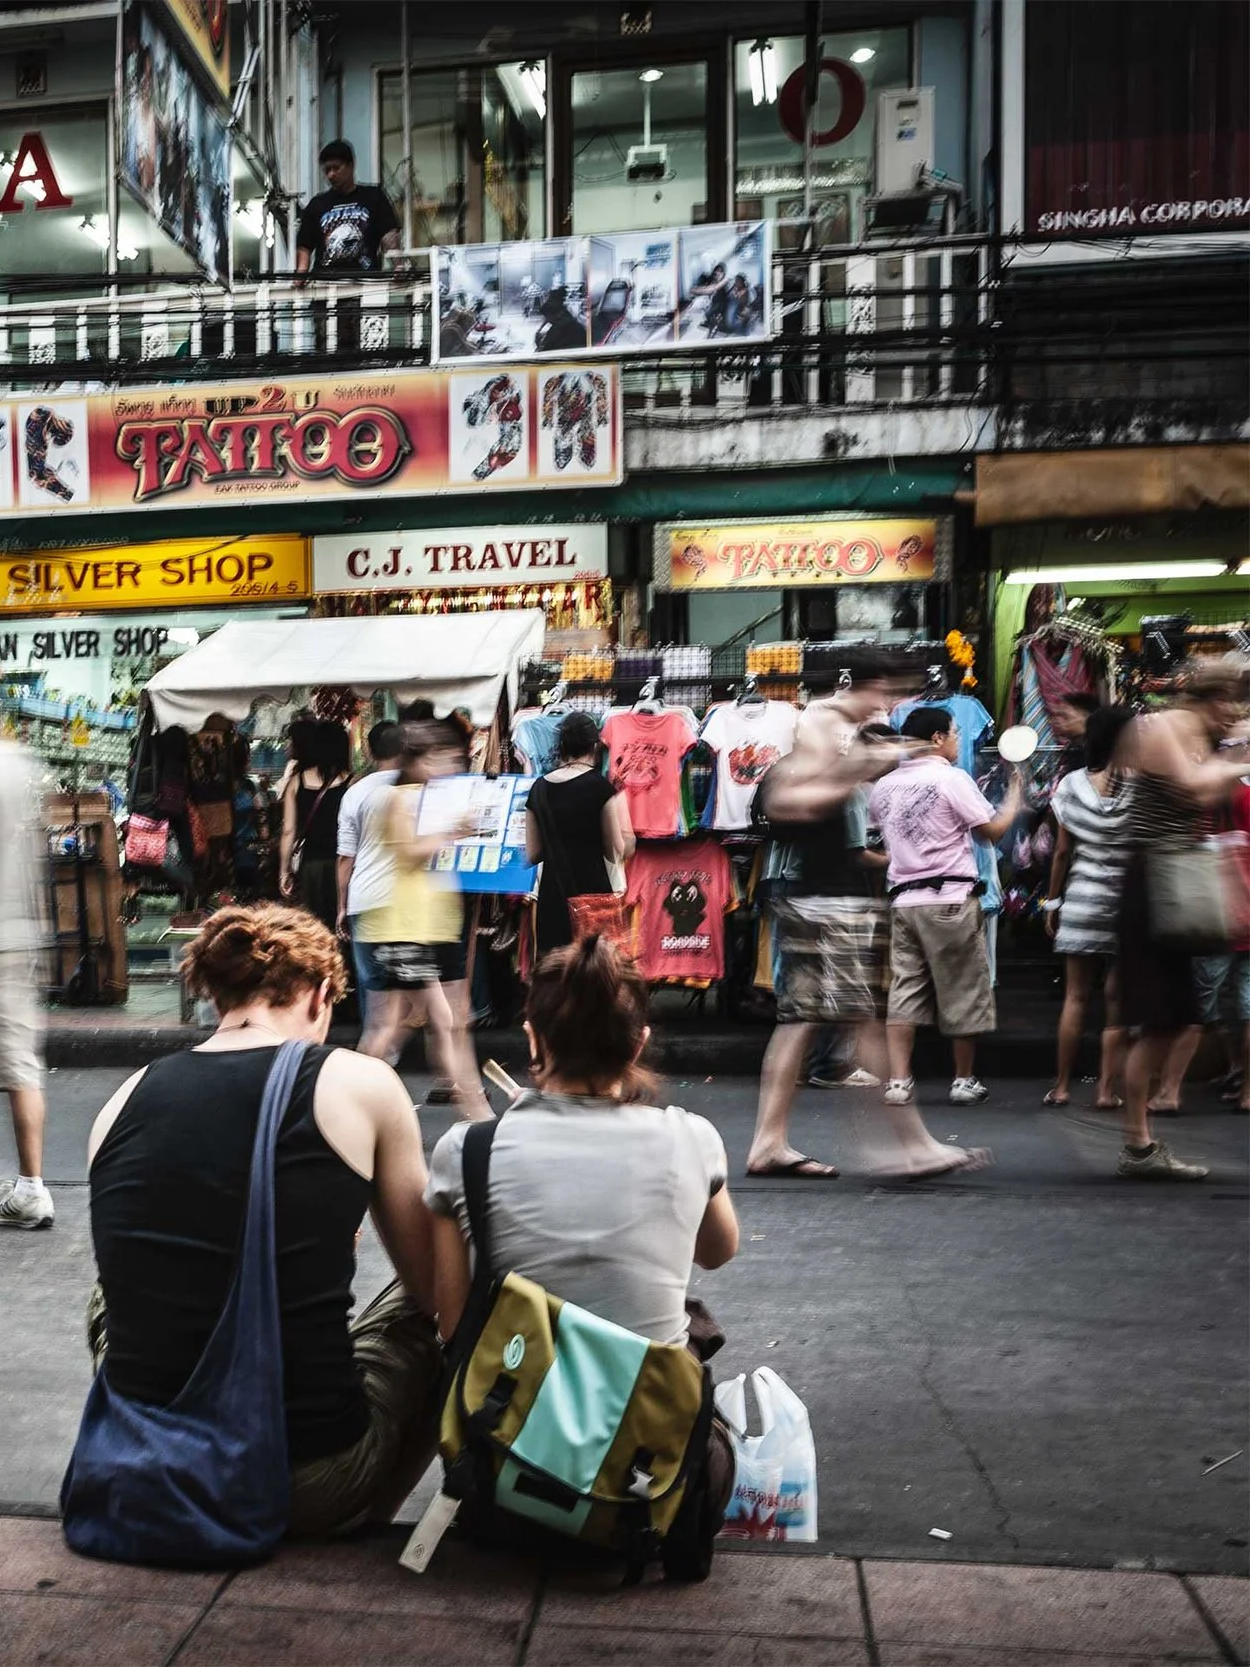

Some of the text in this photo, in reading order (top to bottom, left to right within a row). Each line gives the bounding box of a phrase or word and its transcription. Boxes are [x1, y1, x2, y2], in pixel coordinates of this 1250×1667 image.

[1038, 206, 1137, 232] SINGHA
[117, 406, 414, 502] TATTOO
[236, 482, 267, 492] TATTOO
[269, 480, 300, 490] GROUP
[7, 560, 142, 595] SILVER
[159, 552, 275, 586] SHOP
[347, 537, 577, 580] C.J. TRAVEL
[718, 537, 883, 584] TATTOO
[32, 630, 100, 660] SILVER
[112, 627, 169, 656] SHOP
